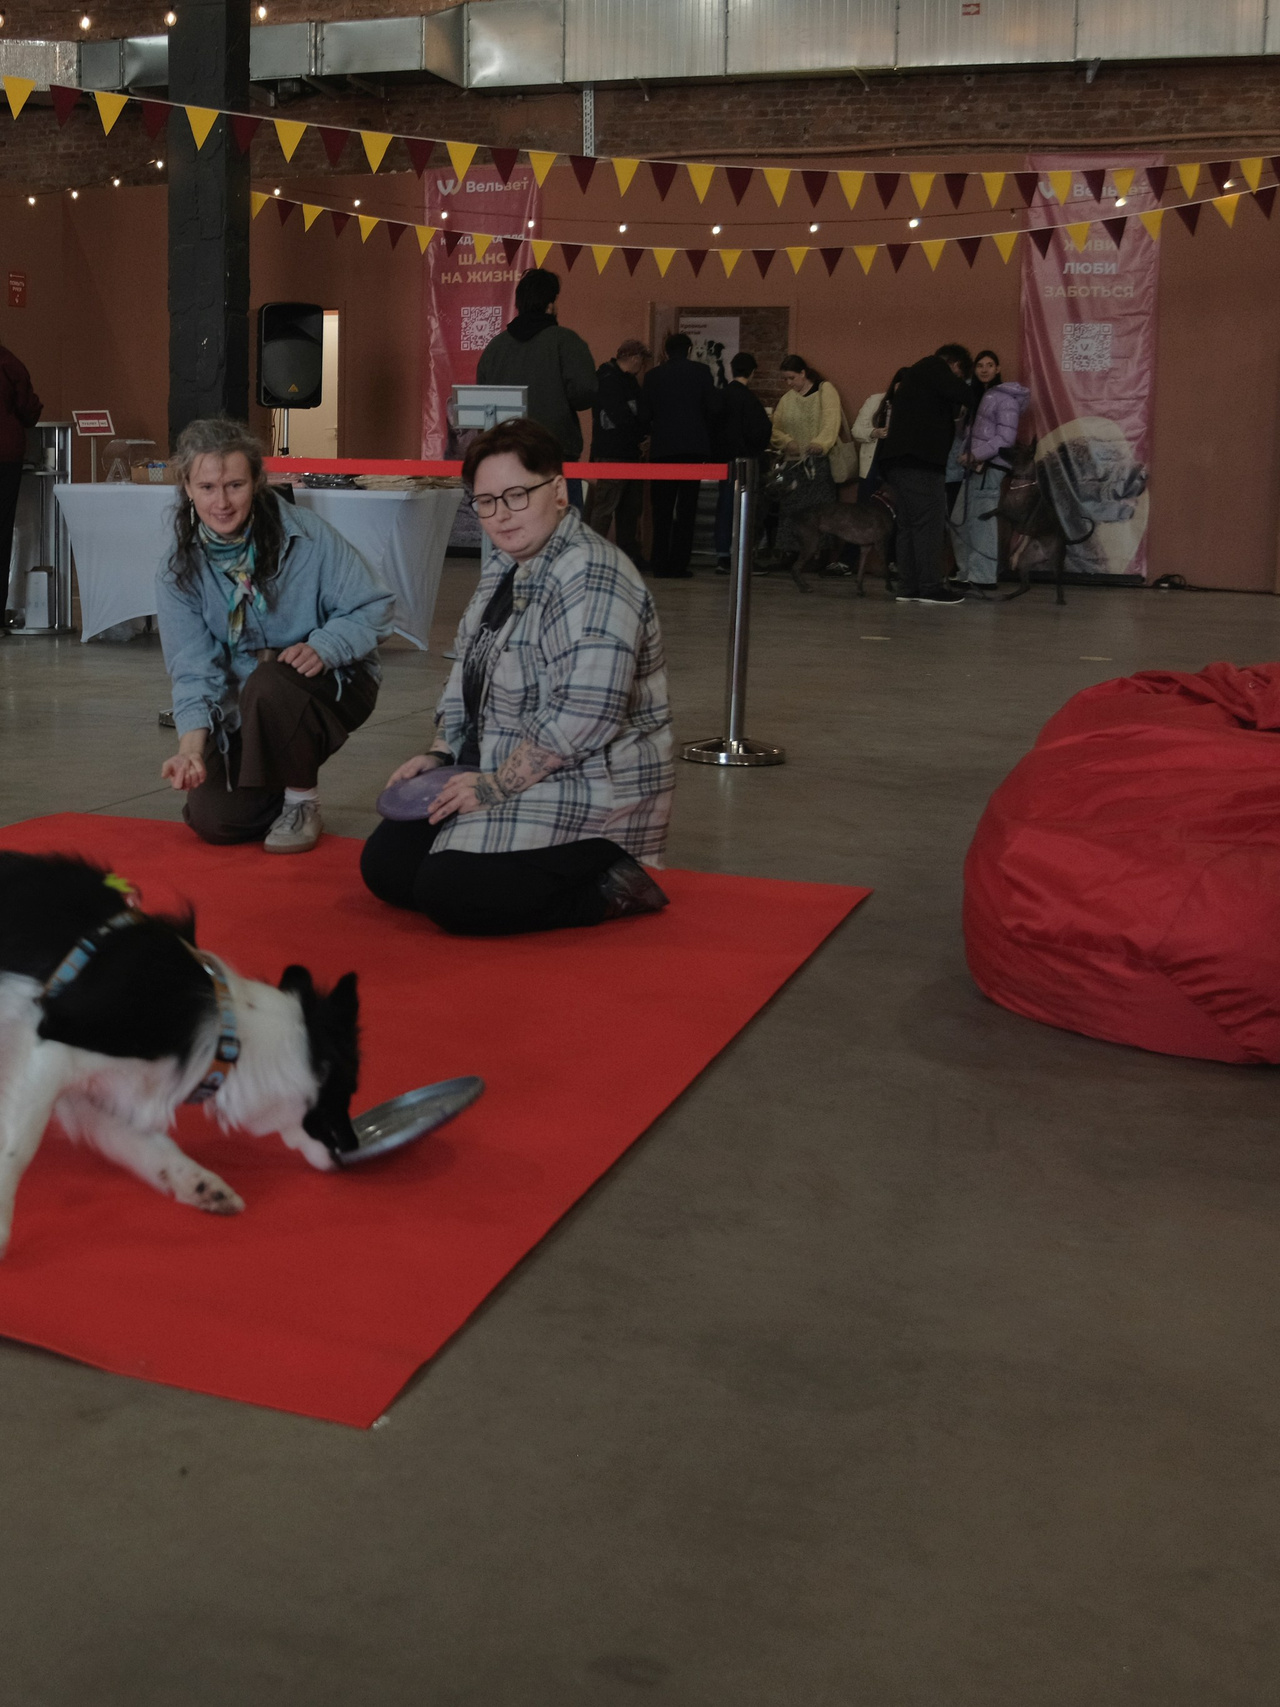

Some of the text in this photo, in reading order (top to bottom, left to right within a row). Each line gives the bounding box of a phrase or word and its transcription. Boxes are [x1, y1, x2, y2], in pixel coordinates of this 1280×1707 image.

[466, 177, 529, 193] Вельвет
[1073, 181, 1149, 197] Вельет
[1063, 262, 1117, 275] ЛЮБИ
[442, 270, 522, 284] НА ЖИЗНЬ
[1044, 286, 1135, 298] ЗАБОТЬСЯ
